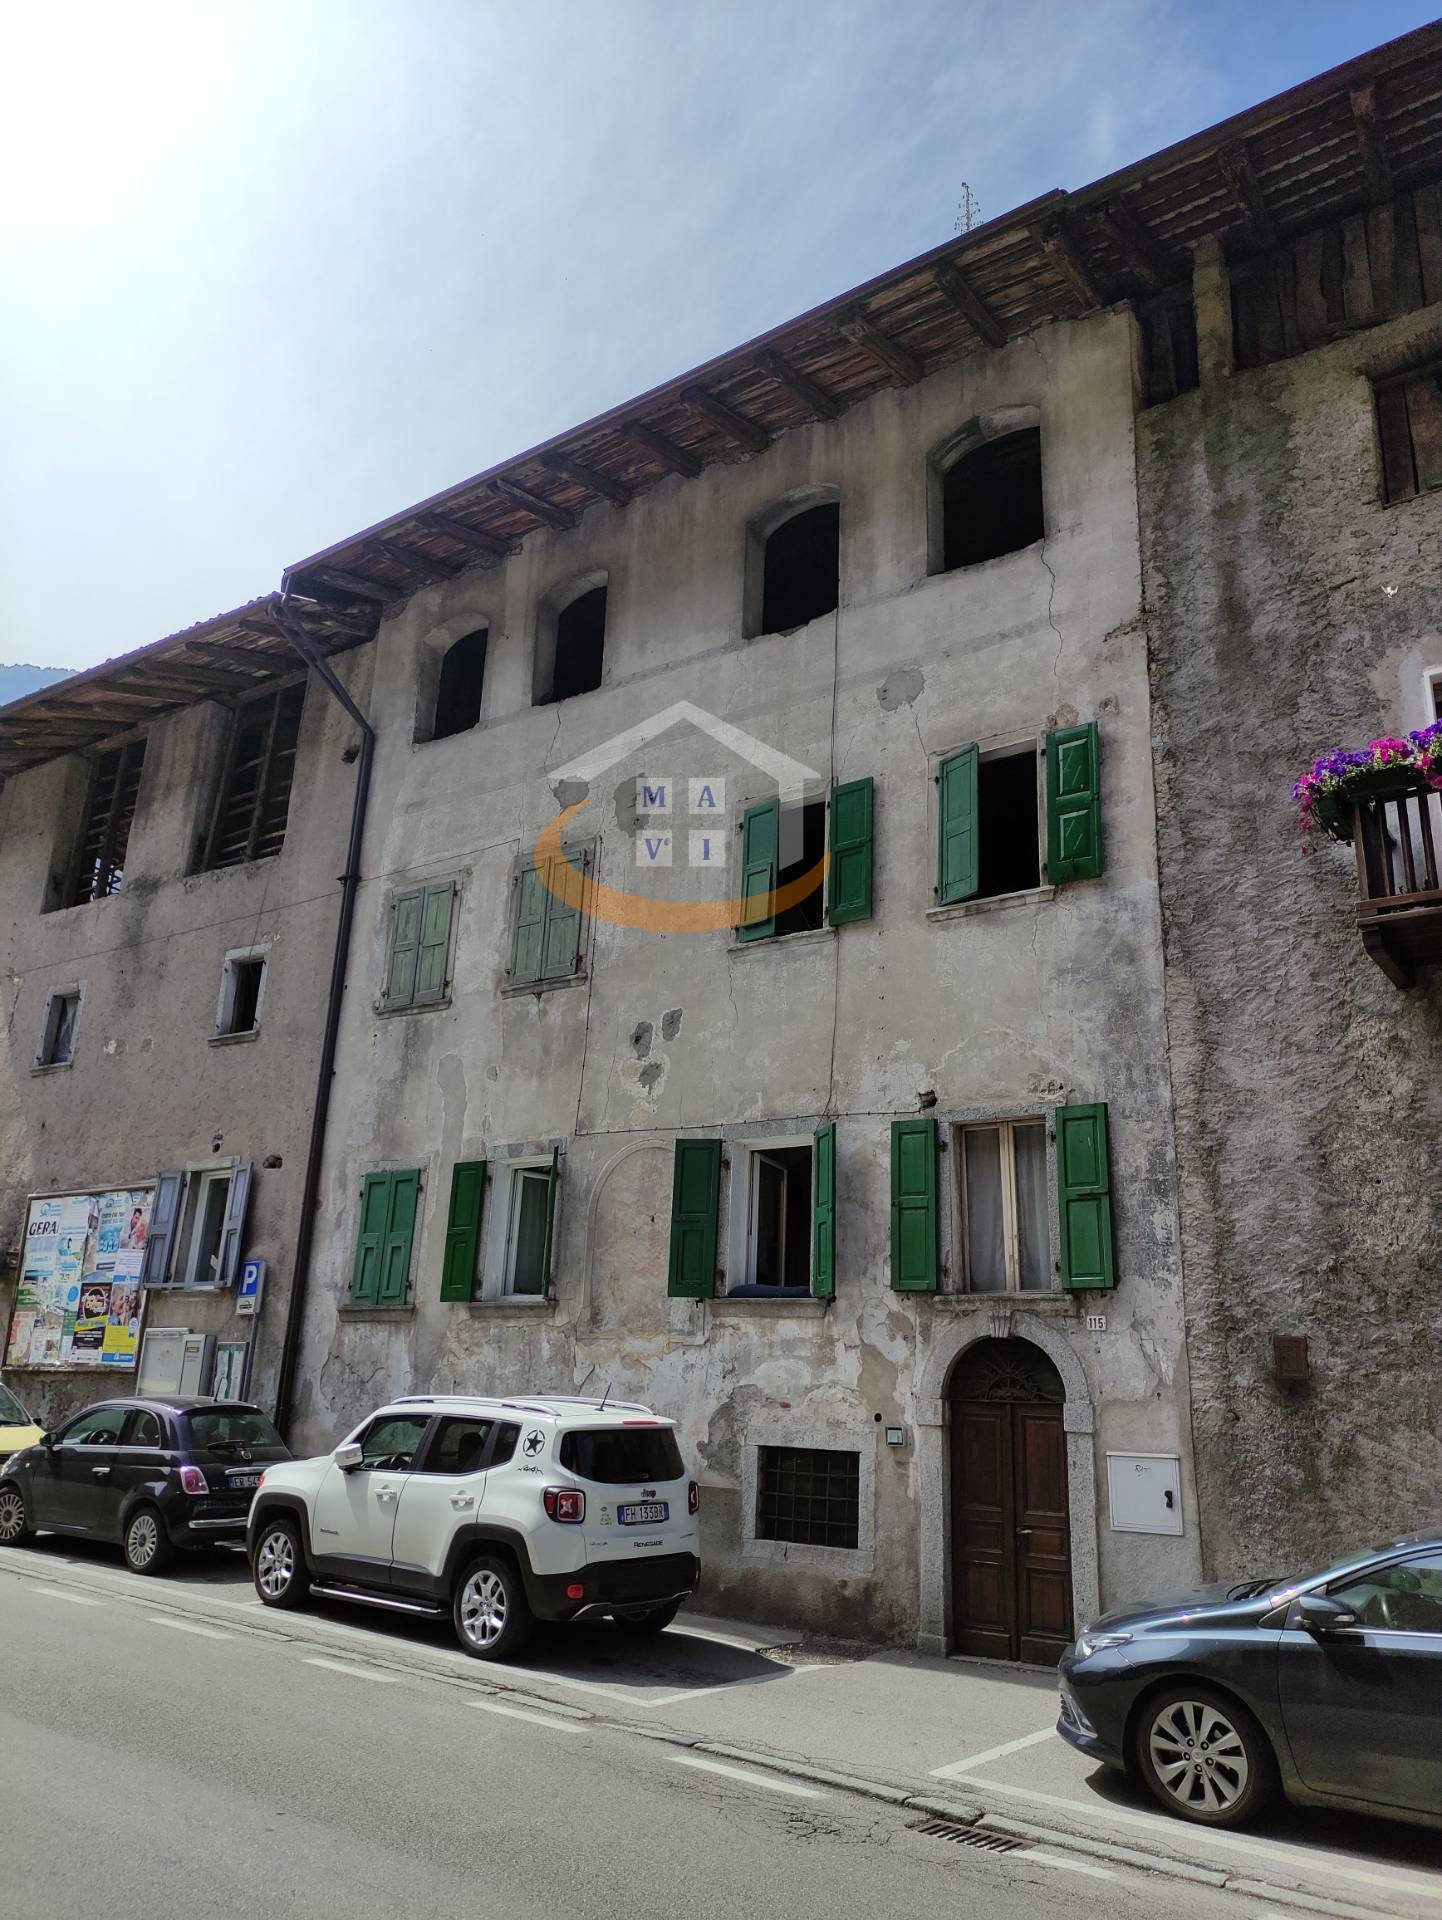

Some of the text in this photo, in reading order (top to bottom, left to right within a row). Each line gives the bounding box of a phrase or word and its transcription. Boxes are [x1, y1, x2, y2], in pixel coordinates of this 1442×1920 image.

[29, 1221, 59, 1236] GERA
[242, 1265, 257, 1293] P
[1088, 1317, 1104, 1329] 115
[625, 1507, 636, 1521] FH
[640, 1505, 664, 1520] 133BR
[633, 1540, 664, 1548] RENEGADE
